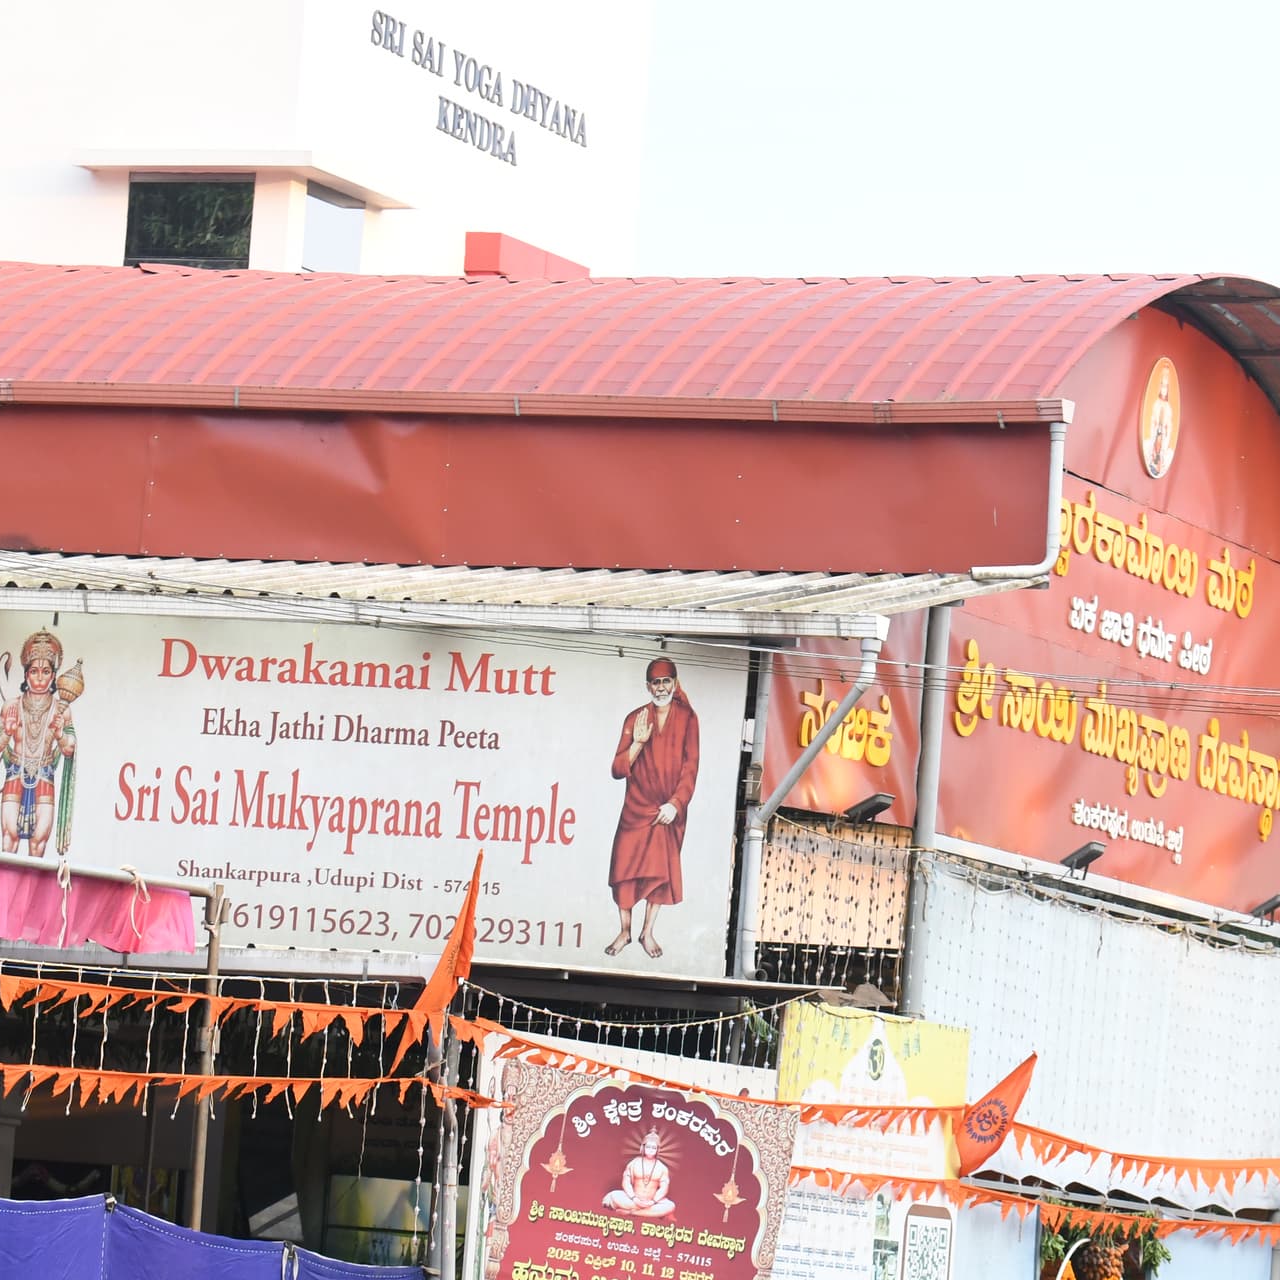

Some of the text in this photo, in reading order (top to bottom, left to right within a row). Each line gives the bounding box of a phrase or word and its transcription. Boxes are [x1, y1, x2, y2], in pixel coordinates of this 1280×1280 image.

[371, 10, 587, 147] SRI SAI YOGA DHYANA
[436, 95, 517, 166] KENDRA
[1099, 609, 1134, 647] ಜಾತಿ
[1136, 615, 1177, 662] ಧರ್ಮ
[158, 638, 557, 696] Dwarakamai Mutt
[200, 707, 500, 750] Ekha Jathi Dharma Peeta
[954, 638, 995, 737] ಶ್ರೀ
[999, 667, 1078, 744] ಸಾಯಿ
[1081, 680, 1191, 798] ಮುಖ್ಯಪ್ರಾಣ
[115, 762, 577, 864] Sri Sai Mukyaprana Temple
[177, 858, 301, 887] Shankarpura
[382, 871, 423, 891] Dist
[444, 879, 501, 896] 57415
[224, 899, 398, 941] 619115623,
[572, 1098, 735, 1157] ಶ್ರೀ ಕ್ಷೇತ್ರ ಶಂಕರಪುರ
[528, 1200, 545, 1222] ಶ್ರೀ
[546, 1246, 580, 1262] 2025
[660, 1266, 675, 1279] 12
[676, 1252, 712, 1267] 574115
